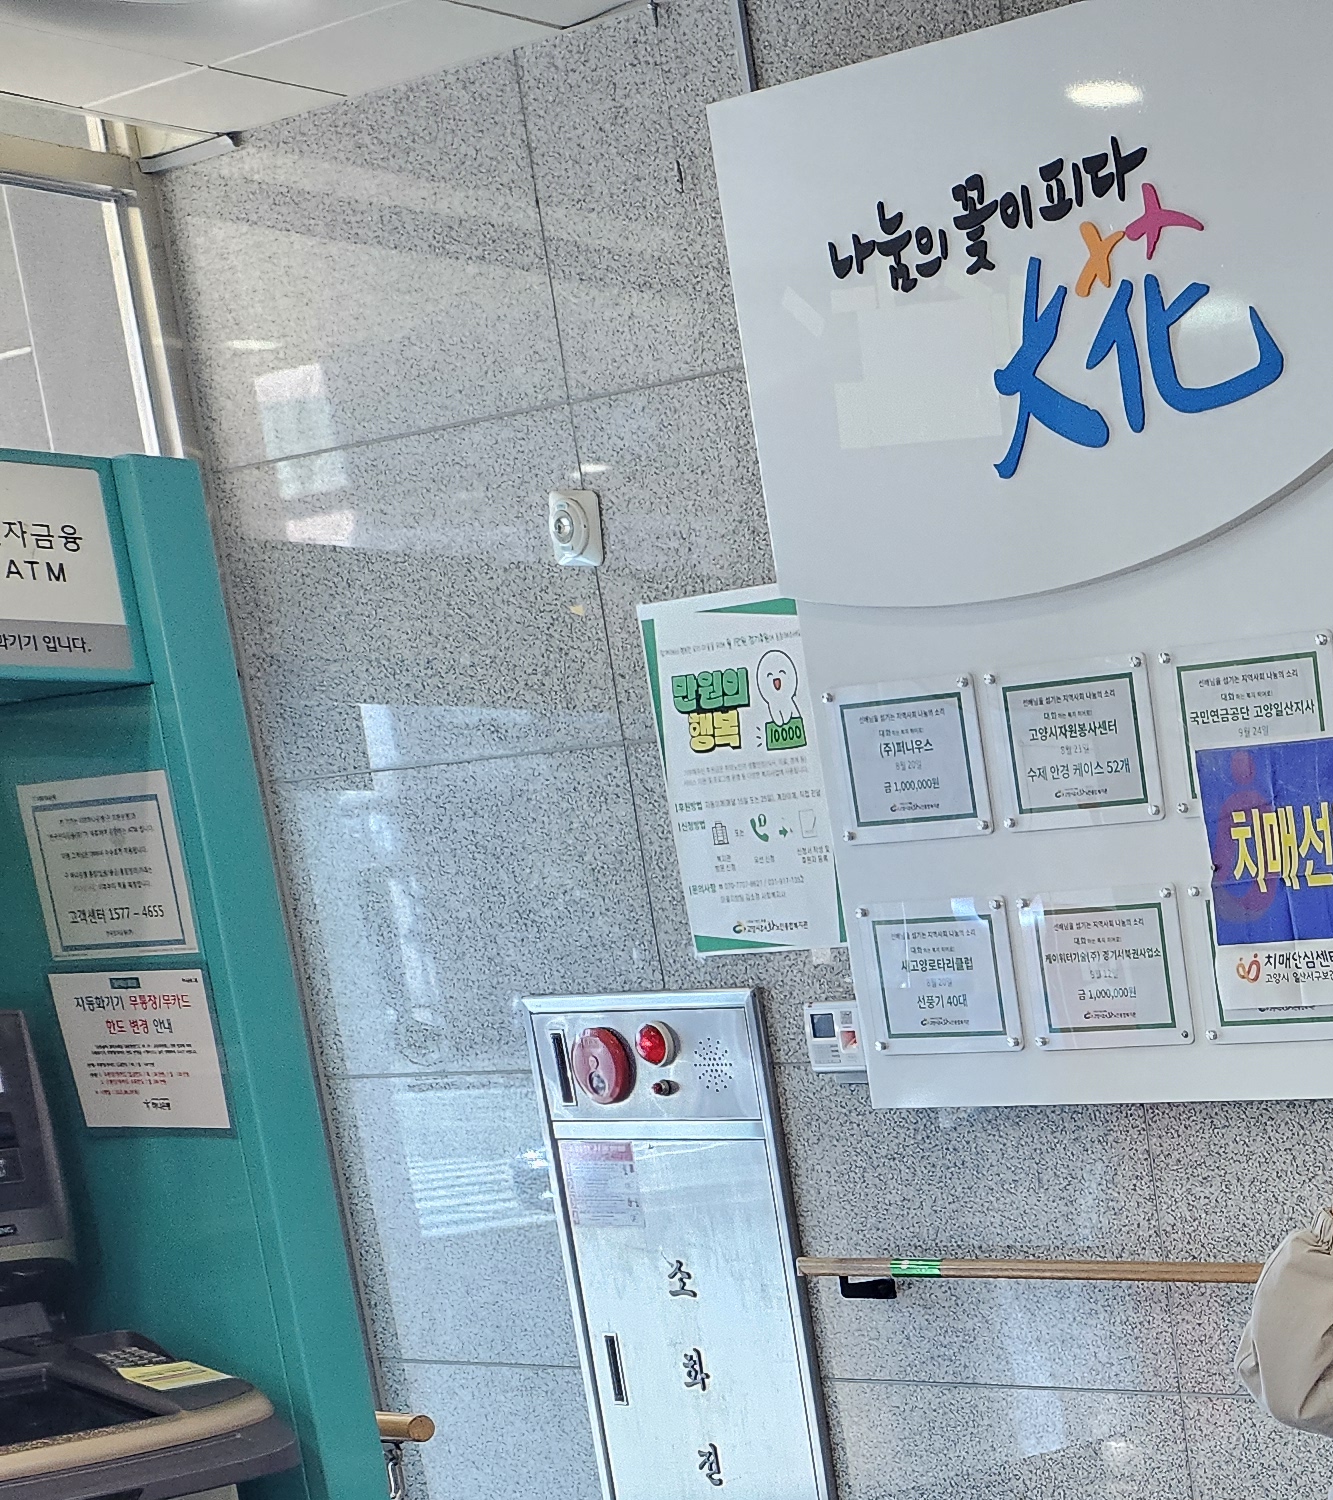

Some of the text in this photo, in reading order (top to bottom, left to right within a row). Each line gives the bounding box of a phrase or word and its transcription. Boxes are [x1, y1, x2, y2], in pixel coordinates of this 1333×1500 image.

[828, 135, 1148, 292] 나눔의 꽃이 피다
[0, 521, 83, 552] 자금융
[5, 559, 67, 582] ATM
[43, 635, 92, 653] 입니다.
[1241, 672, 1265, 683] 지역사회
[1286, 668, 1298, 678] 소리
[671, 667, 750, 714] 만원의
[1190, 698, 1315, 725] 국민연금공단 고양일산지사
[688, 707, 742, 753] 행복
[770, 725, 801, 743] 10000
[1029, 719, 1118, 741] 고양시자원봉사센터
[1238, 725, 1269, 738] 9월 24일
[880, 739, 934, 758] (주)퍼니우스
[1028, 758, 1130, 782] 수제 안경 케이스 52개
[884, 777, 940, 793] 금 1,000,000원
[68, 904, 165, 924] 고객센터 1577 4655
[1102, 947, 1161, 961] 경기서북권사업소
[1265, 972, 1290, 984] 고양시
[917, 993, 968, 1009] 선풍기 40대
[1078, 986, 1137, 1001] 금 1,000,000원
[74, 995, 125, 1011] 자동화기기
[129, 1018, 149, 1034] 변경
[153, 1017, 173, 1034] 안내
